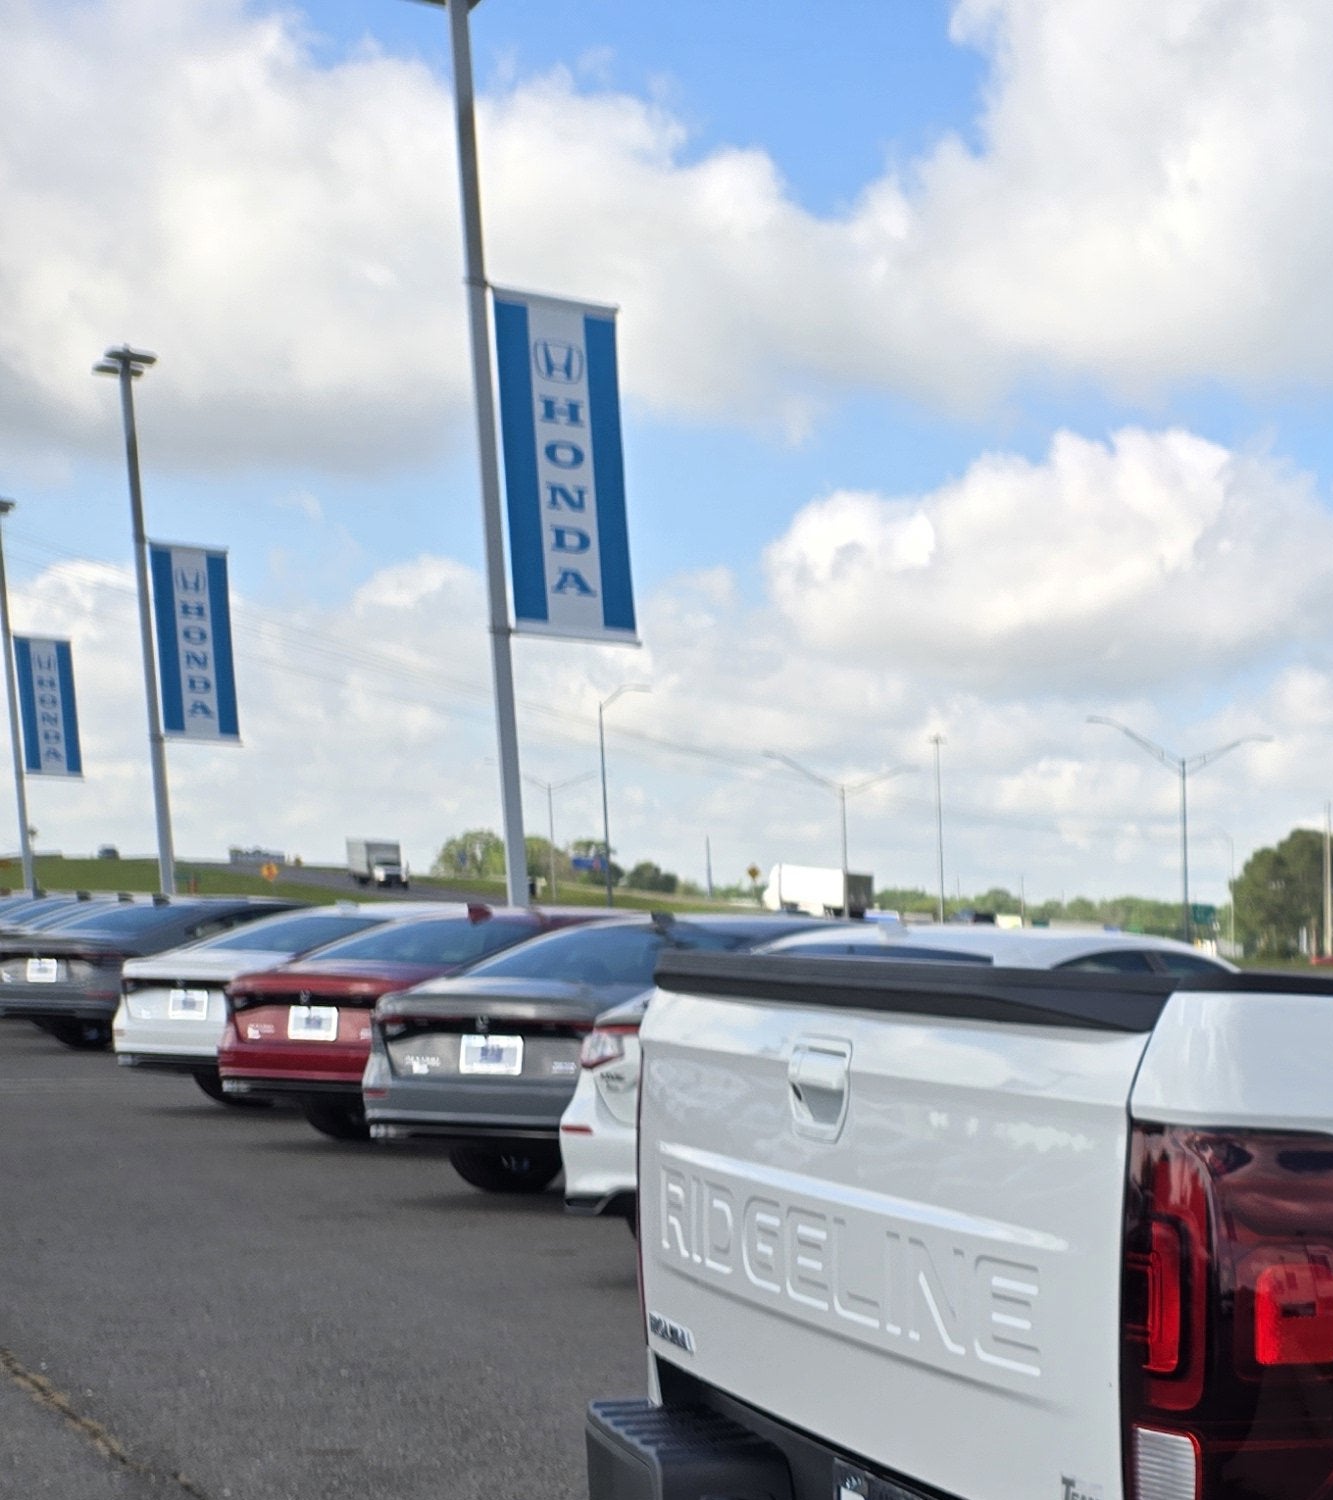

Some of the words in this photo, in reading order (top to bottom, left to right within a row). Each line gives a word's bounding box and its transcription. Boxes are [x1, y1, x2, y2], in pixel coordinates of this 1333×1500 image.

[538, 393, 598, 598] HONDA
[36, 675, 63, 762] HONDA
[180, 599, 214, 719] HONDA
[660, 1163, 1042, 1378] RIDGELINE
